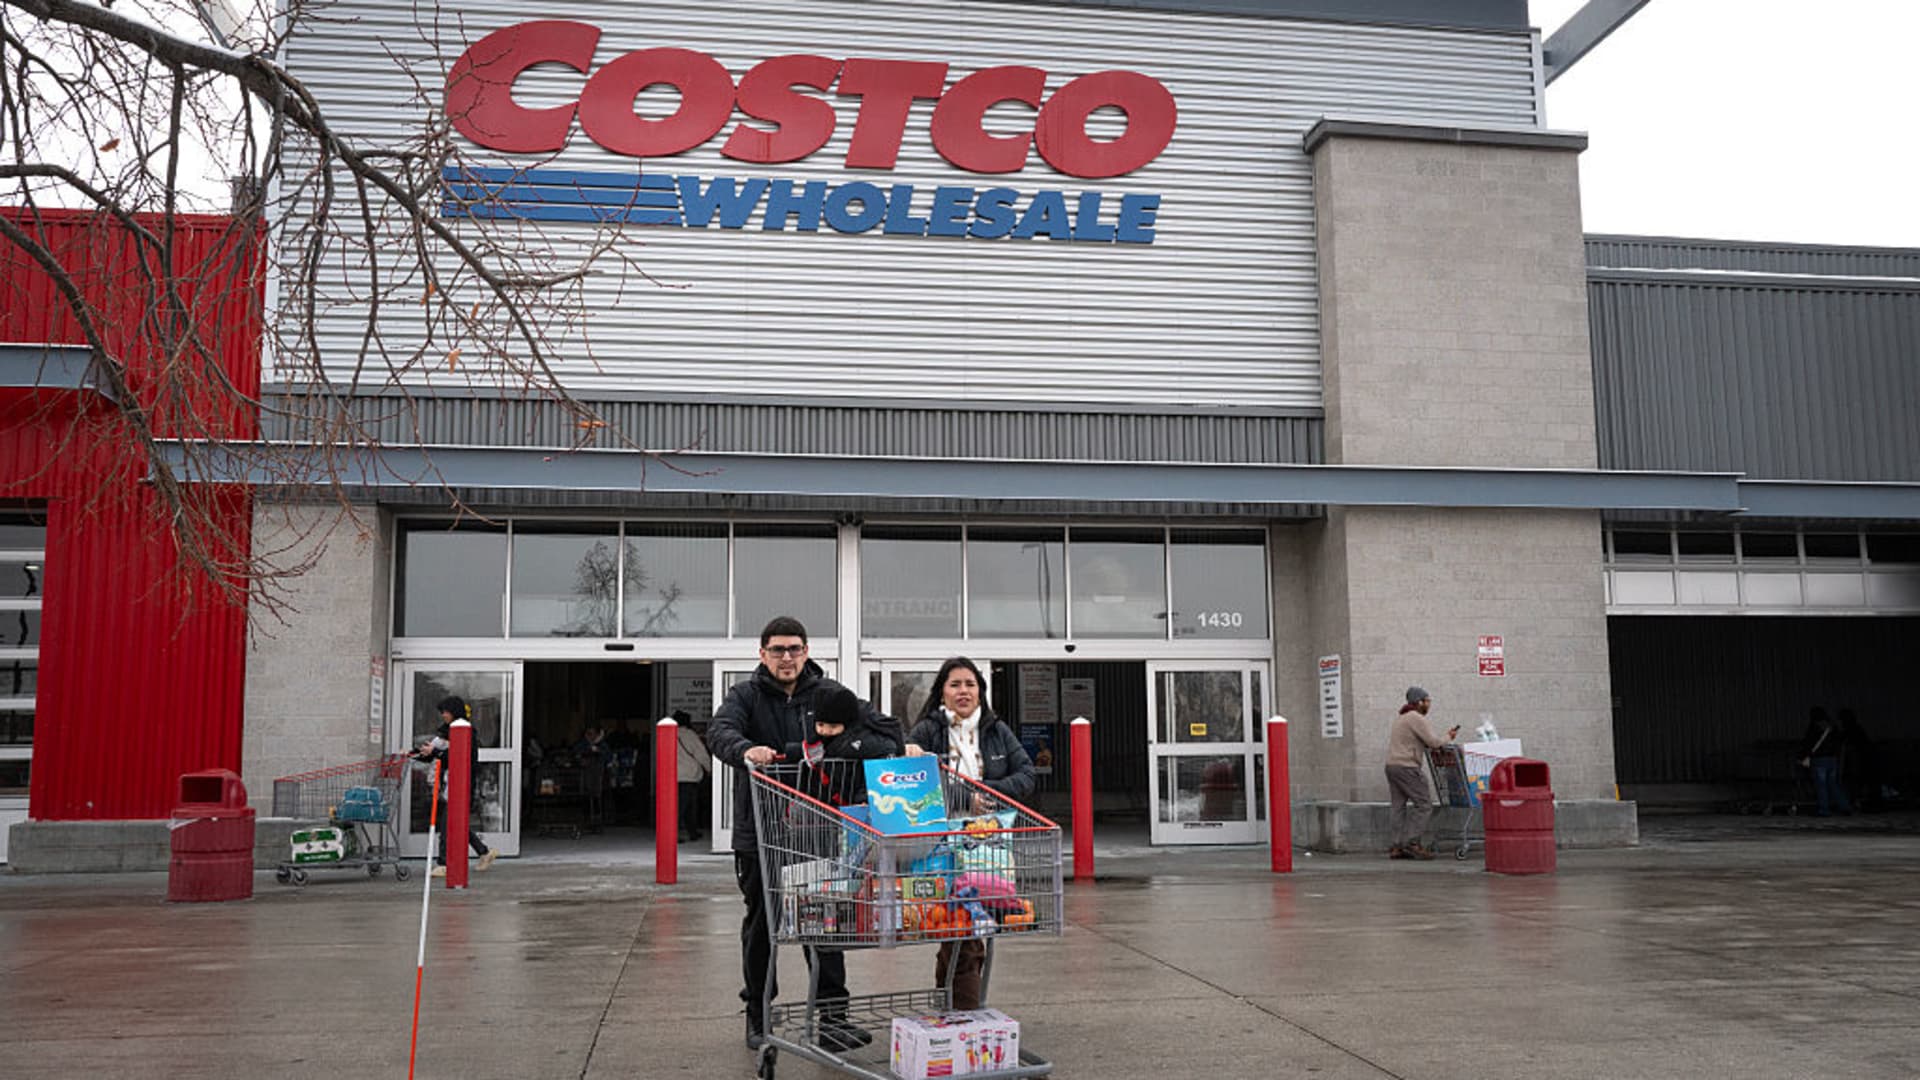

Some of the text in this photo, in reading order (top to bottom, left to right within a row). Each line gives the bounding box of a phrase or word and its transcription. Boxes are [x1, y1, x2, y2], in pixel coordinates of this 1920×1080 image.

[443, 19, 1178, 179] COSTCO
[677, 175, 1161, 244] WHOLESALE
[1198, 612, 1242, 627] 1430
[880, 771, 926, 785] Crest
